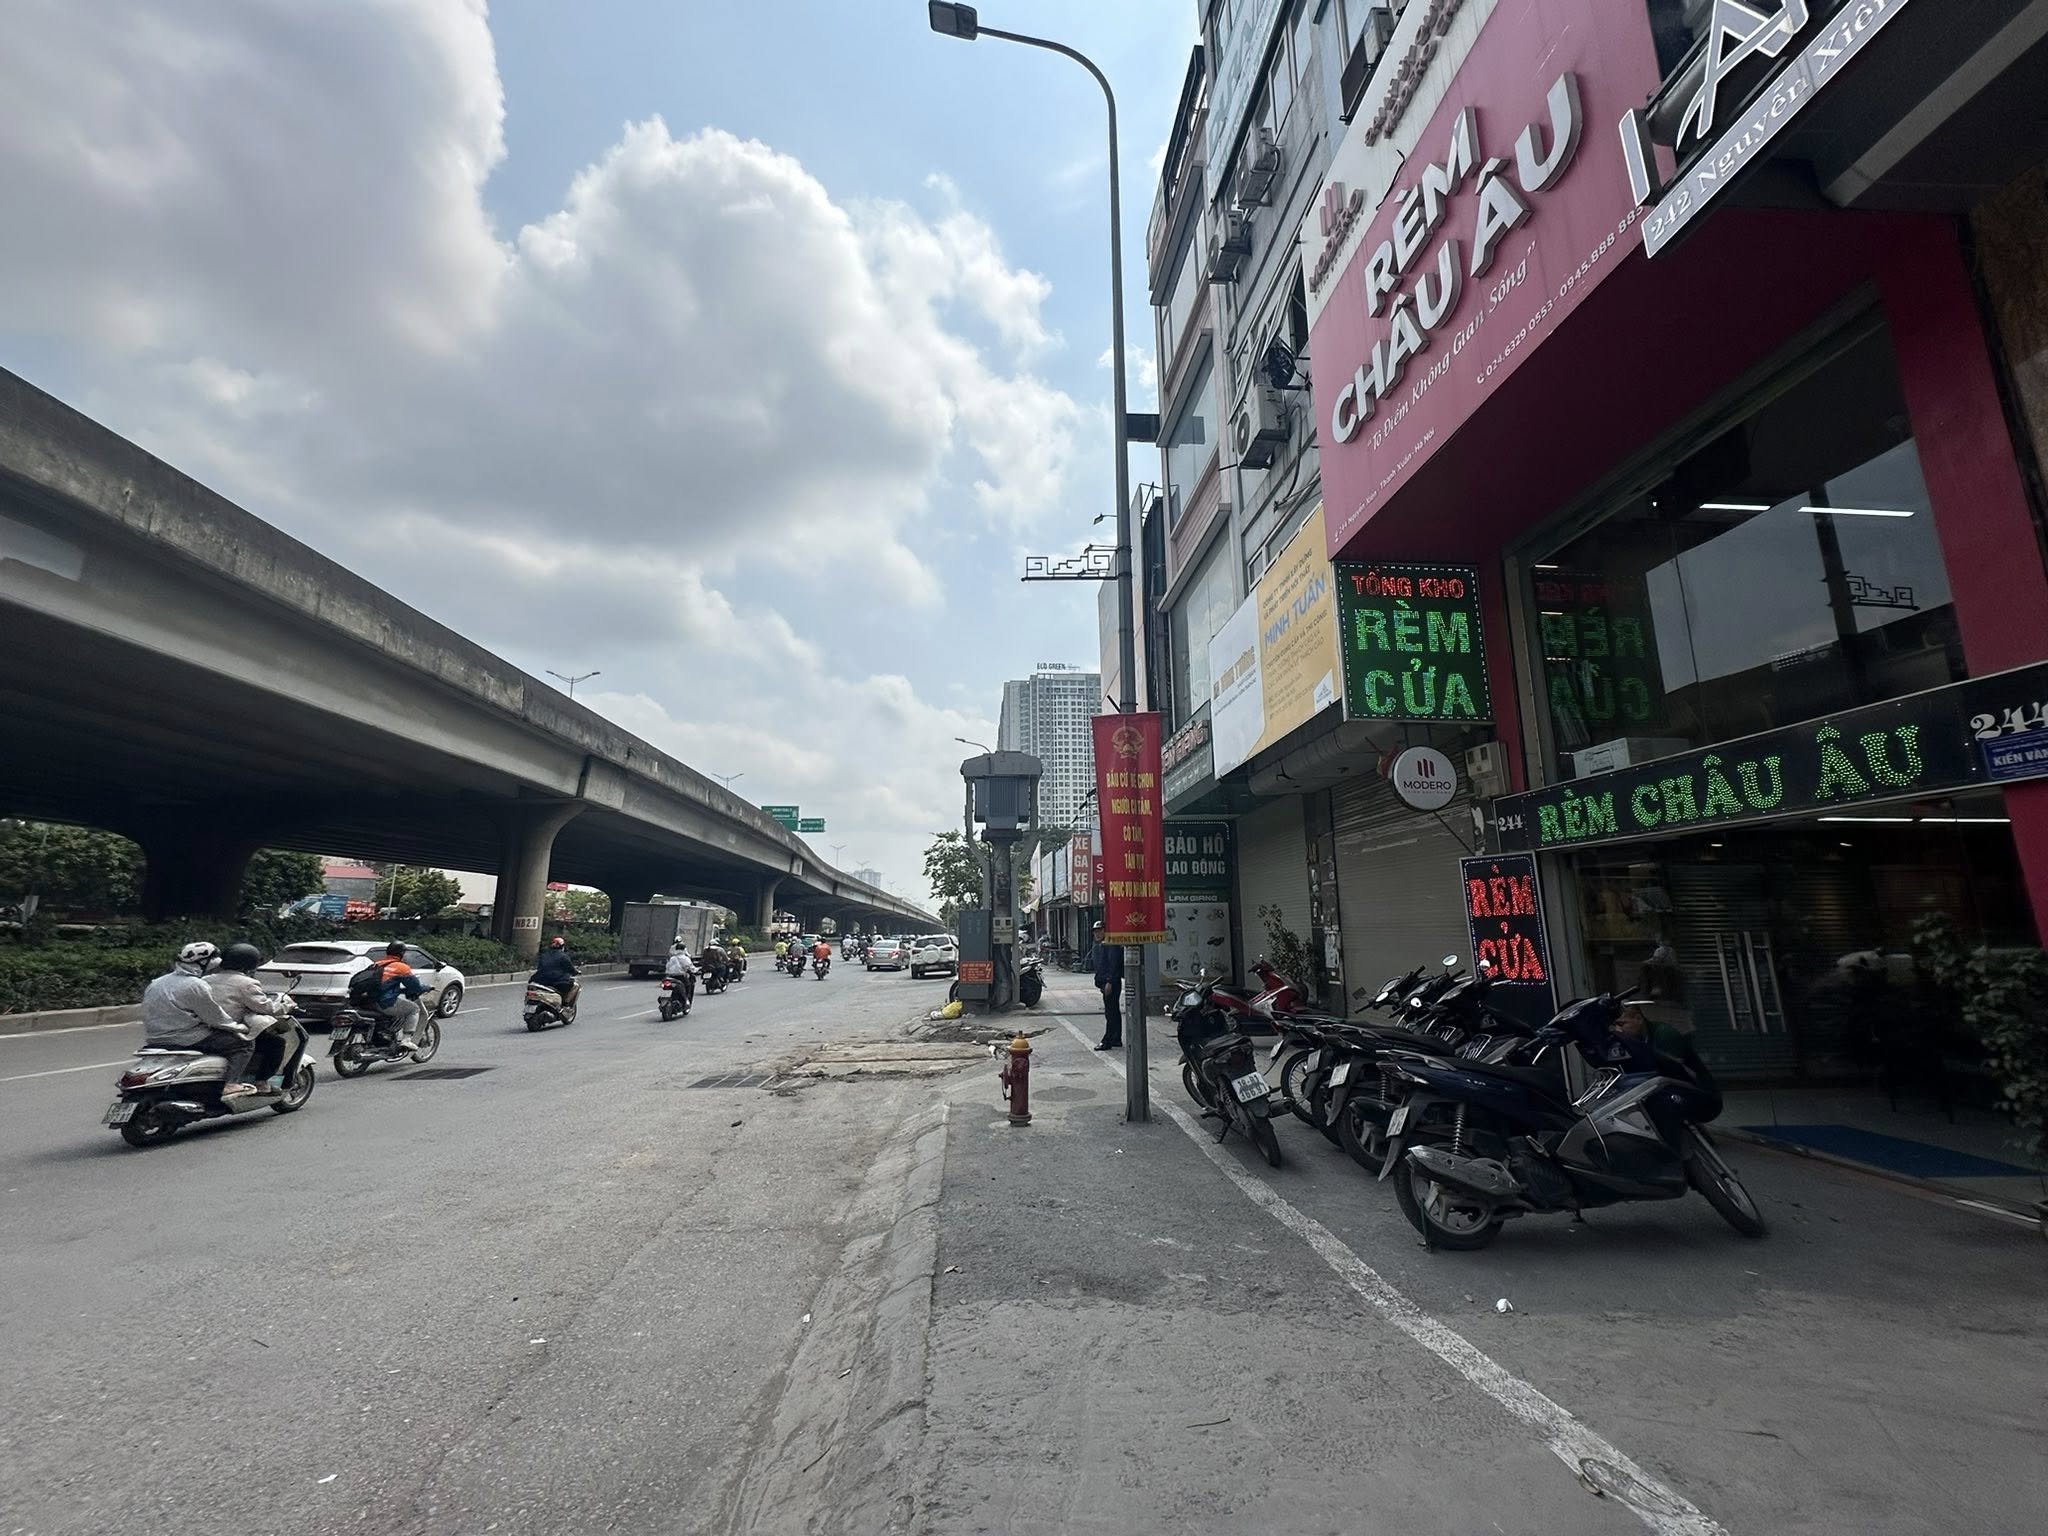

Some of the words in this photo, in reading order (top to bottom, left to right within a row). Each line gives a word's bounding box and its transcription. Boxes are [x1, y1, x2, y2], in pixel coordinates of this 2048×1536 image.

[1651, 191, 1692, 241] 242
[1696, 77, 1809, 192] Nguyễn
[1813, 0, 1886, 75] Xiê
[1364, 106, 1481, 318] RÈM
[1332, 239, 1463, 444] CHÂU
[1470, 72, 1583, 279] ÂU
[1559, 232, 1615, 297] 0945.888
[1412, 352, 1450, 406] Không
[1453, 310, 1485, 356] Gian
[1264, 609, 1290, 650] MINH
[1292, 571, 1326, 624] TUẤN
[1419, 578, 1465, 598] KHO
[1355, 600, 1470, 653] RÈM
[1365, 658, 1477, 715] CỬA
[1403, 781, 1451, 790] MODERO
[1537, 788, 1619, 842] RÈM
[1631, 754, 1784, 826] CHÂU
[1815, 724, 1922, 799] ÂU
[1075, 837, 1088, 850] XE
[1164, 830, 1197, 854] BẢO
[1203, 832, 1224, 857] HỘ
[1498, 814, 1523, 832] 244
[1074, 855, 1088, 868] GA
[1074, 873, 1088, 885] XE
[1166, 861, 1188, 875] LAO
[1192, 858, 1225, 877] ĐỘNG
[1073, 886, 1088, 903] SỐ
[1469, 864, 1536, 918] RÈM
[1478, 921, 1545, 980] CỬA
